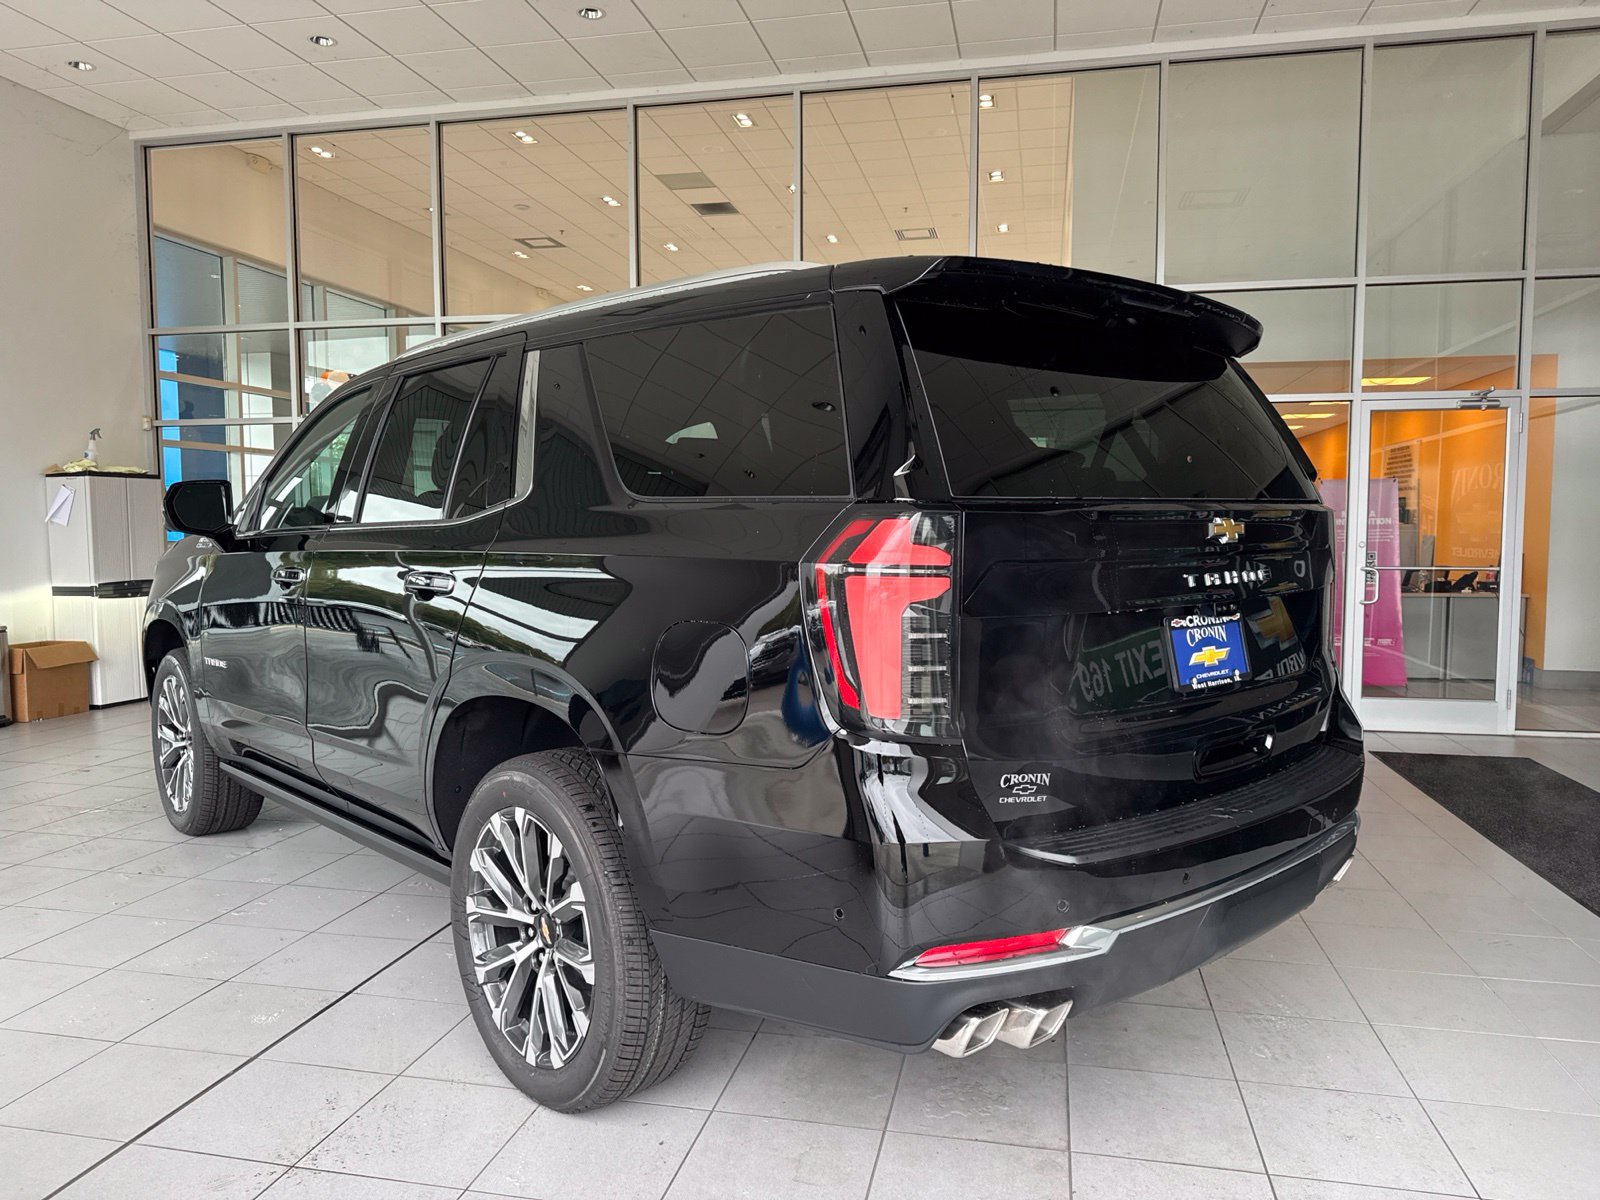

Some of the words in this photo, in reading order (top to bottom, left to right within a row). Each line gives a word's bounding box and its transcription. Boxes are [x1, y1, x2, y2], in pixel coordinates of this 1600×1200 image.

[1182, 568, 1271, 588] TAHOE
[1186, 625, 1227, 647] CRONIN
[1196, 669, 1230, 680] CHEVROLET
[1192, 681, 1207, 690] West
[1000, 772, 1051, 788] CRONIN
[999, 795, 1048, 804] CHEVROLET
